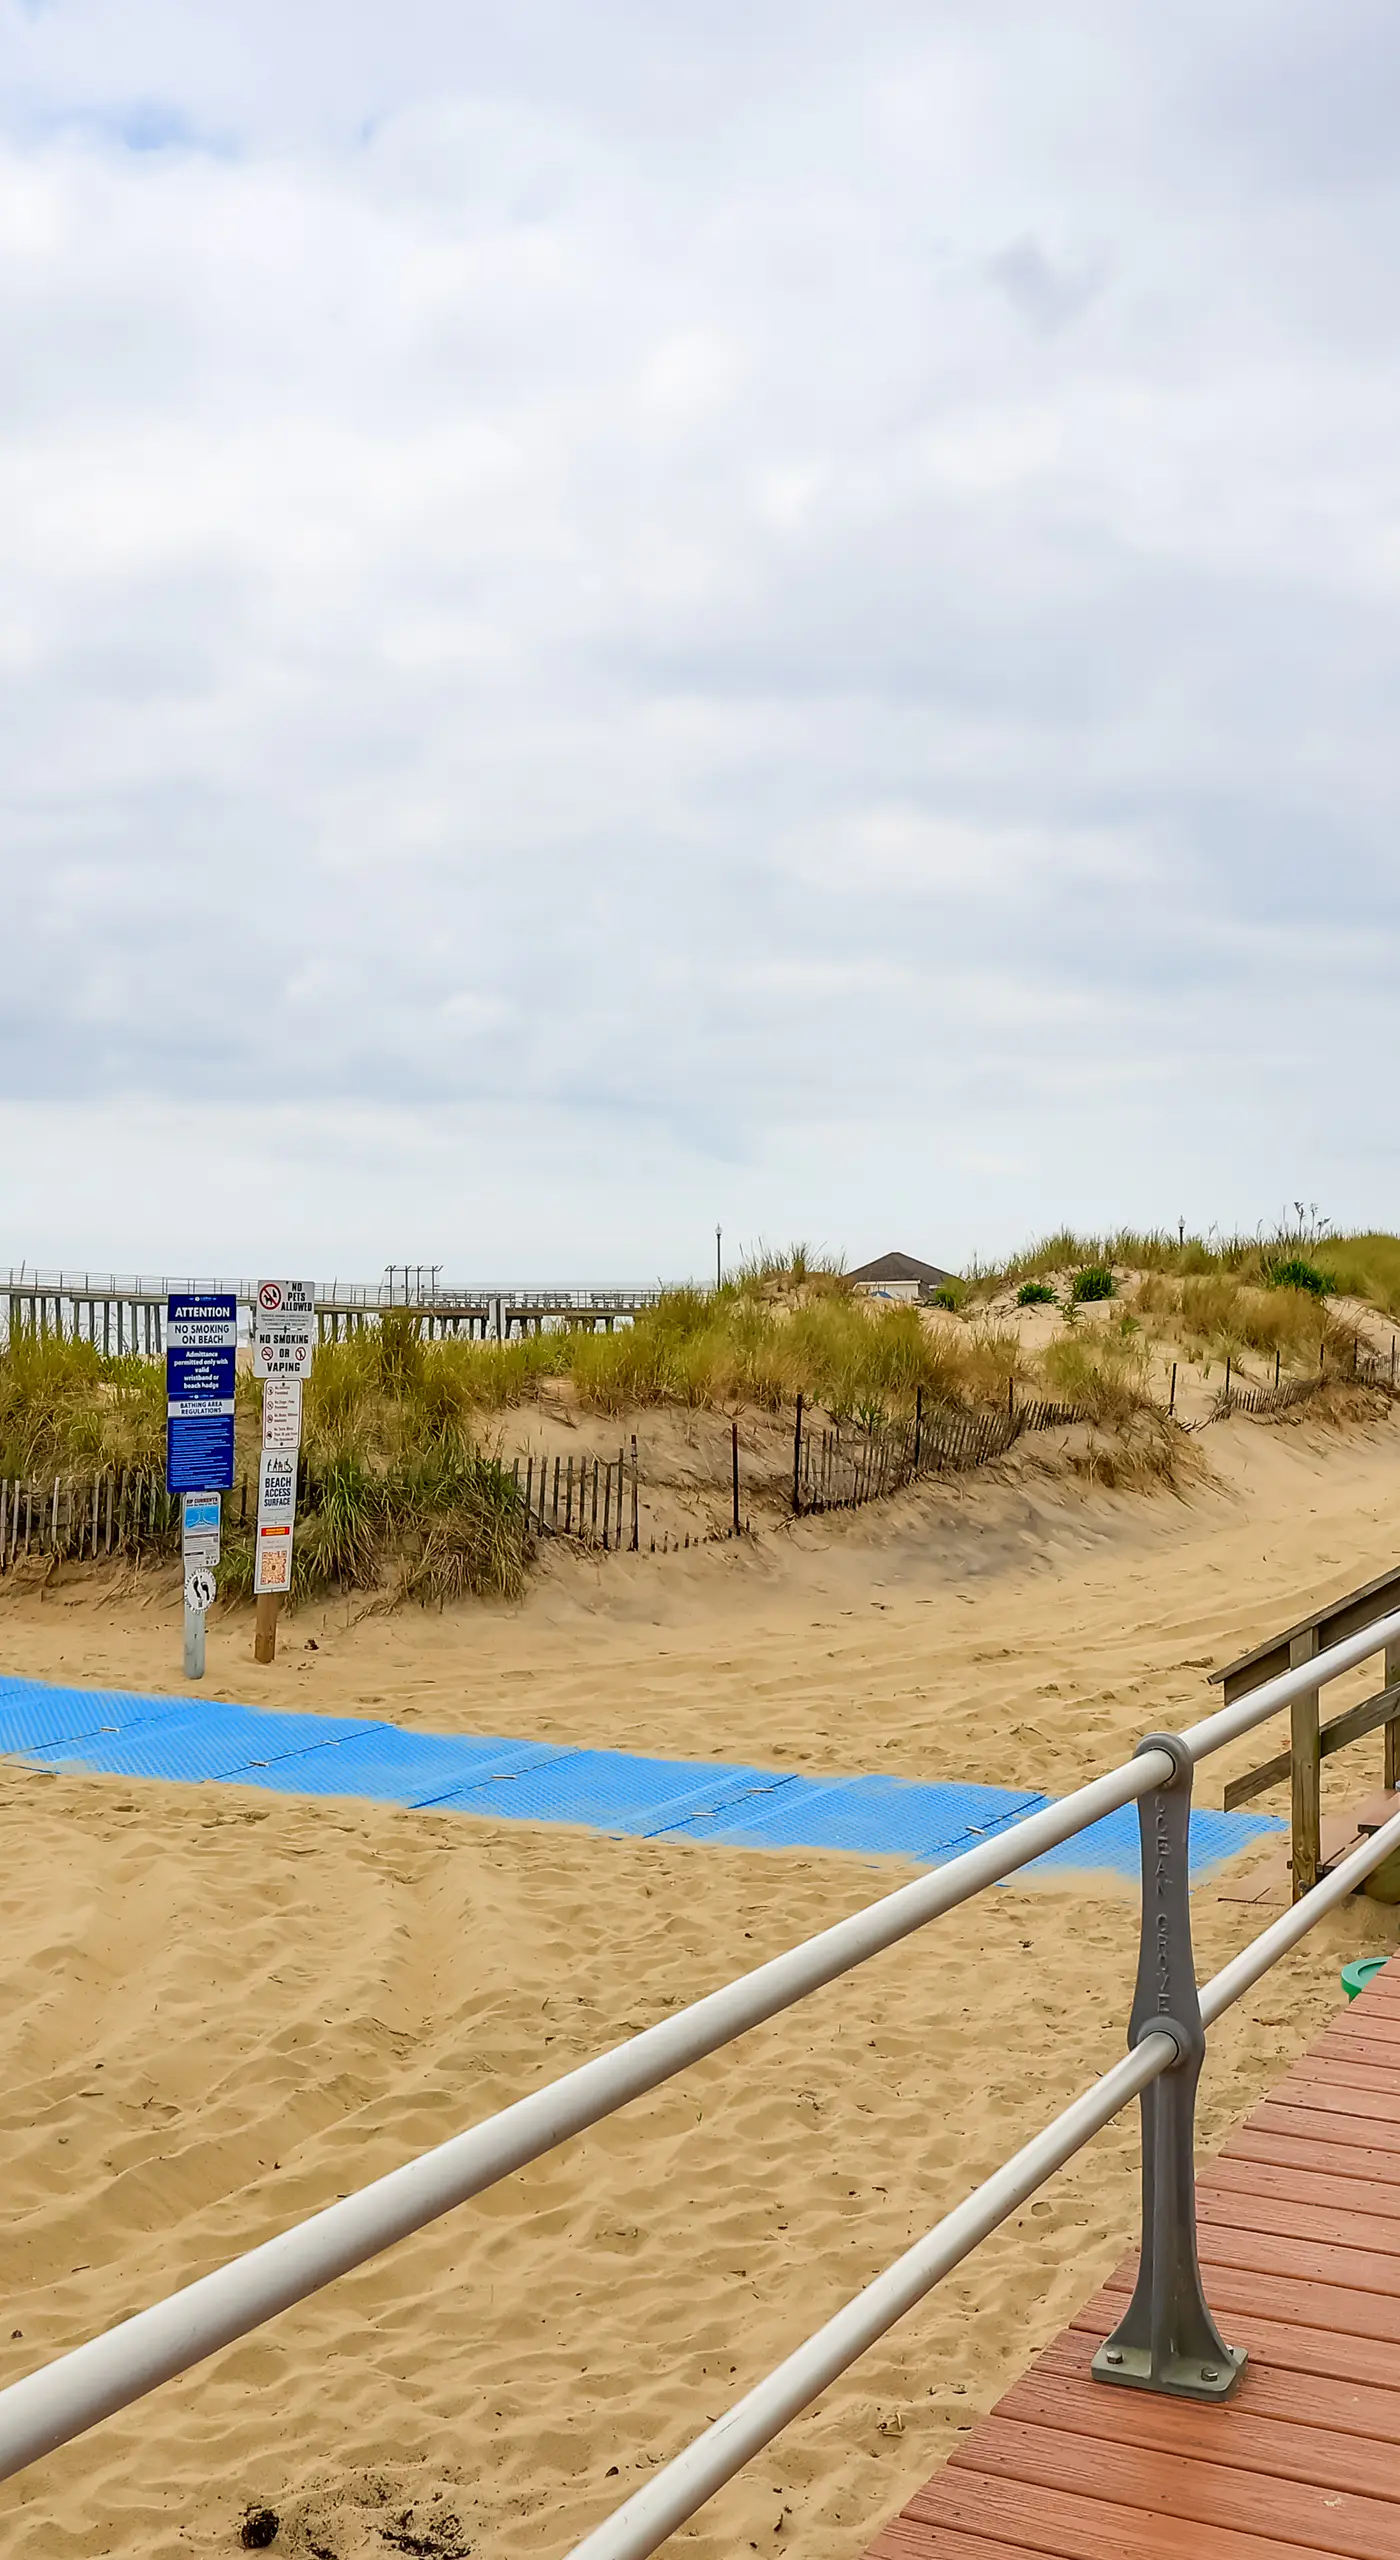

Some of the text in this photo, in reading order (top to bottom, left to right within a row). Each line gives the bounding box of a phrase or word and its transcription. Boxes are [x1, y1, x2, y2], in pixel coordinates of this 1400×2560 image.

[292, 1283, 302, 1291] NO
[288, 1292, 305, 1301] PETS
[281, 1302, 312, 1311] ALLOWED
[175, 1307, 230, 1317] ATTENTION
[175, 1324, 229, 1333] NO SMOKING
[182, 1335, 223, 1344] ON BEACH
[260, 1334, 308, 1344] NO SMOKING
[279, 1348, 290, 1358] OR
[267, 1362, 300, 1372] VAPING
[265, 1477, 291, 1488] BEACH
[265, 1488, 291, 1497] ACCESS
[264, 1497, 291, 1506] SURFACE
